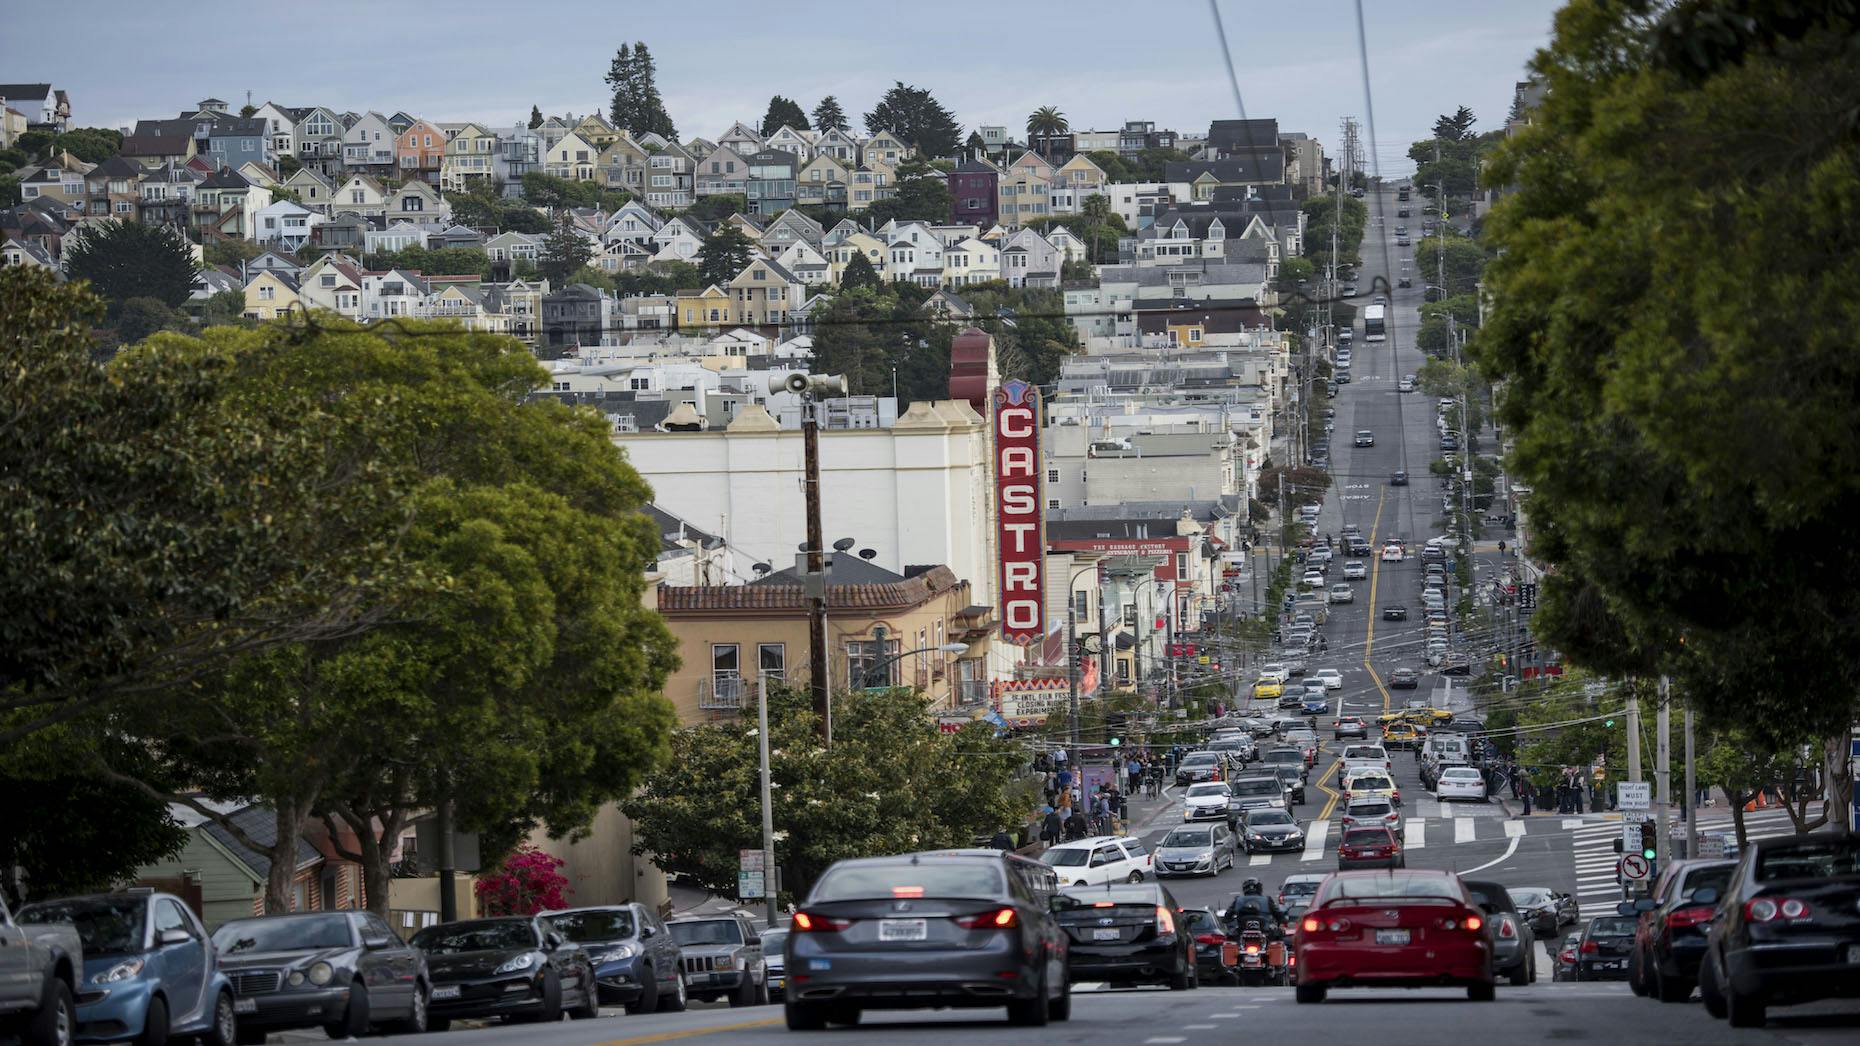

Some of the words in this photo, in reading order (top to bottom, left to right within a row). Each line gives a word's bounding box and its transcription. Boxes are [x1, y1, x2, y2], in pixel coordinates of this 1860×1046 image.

[1000, 408, 1039, 629] CASTRO
[1038, 692, 1053, 700] FILM
[1017, 700, 1045, 708] CLOSING
